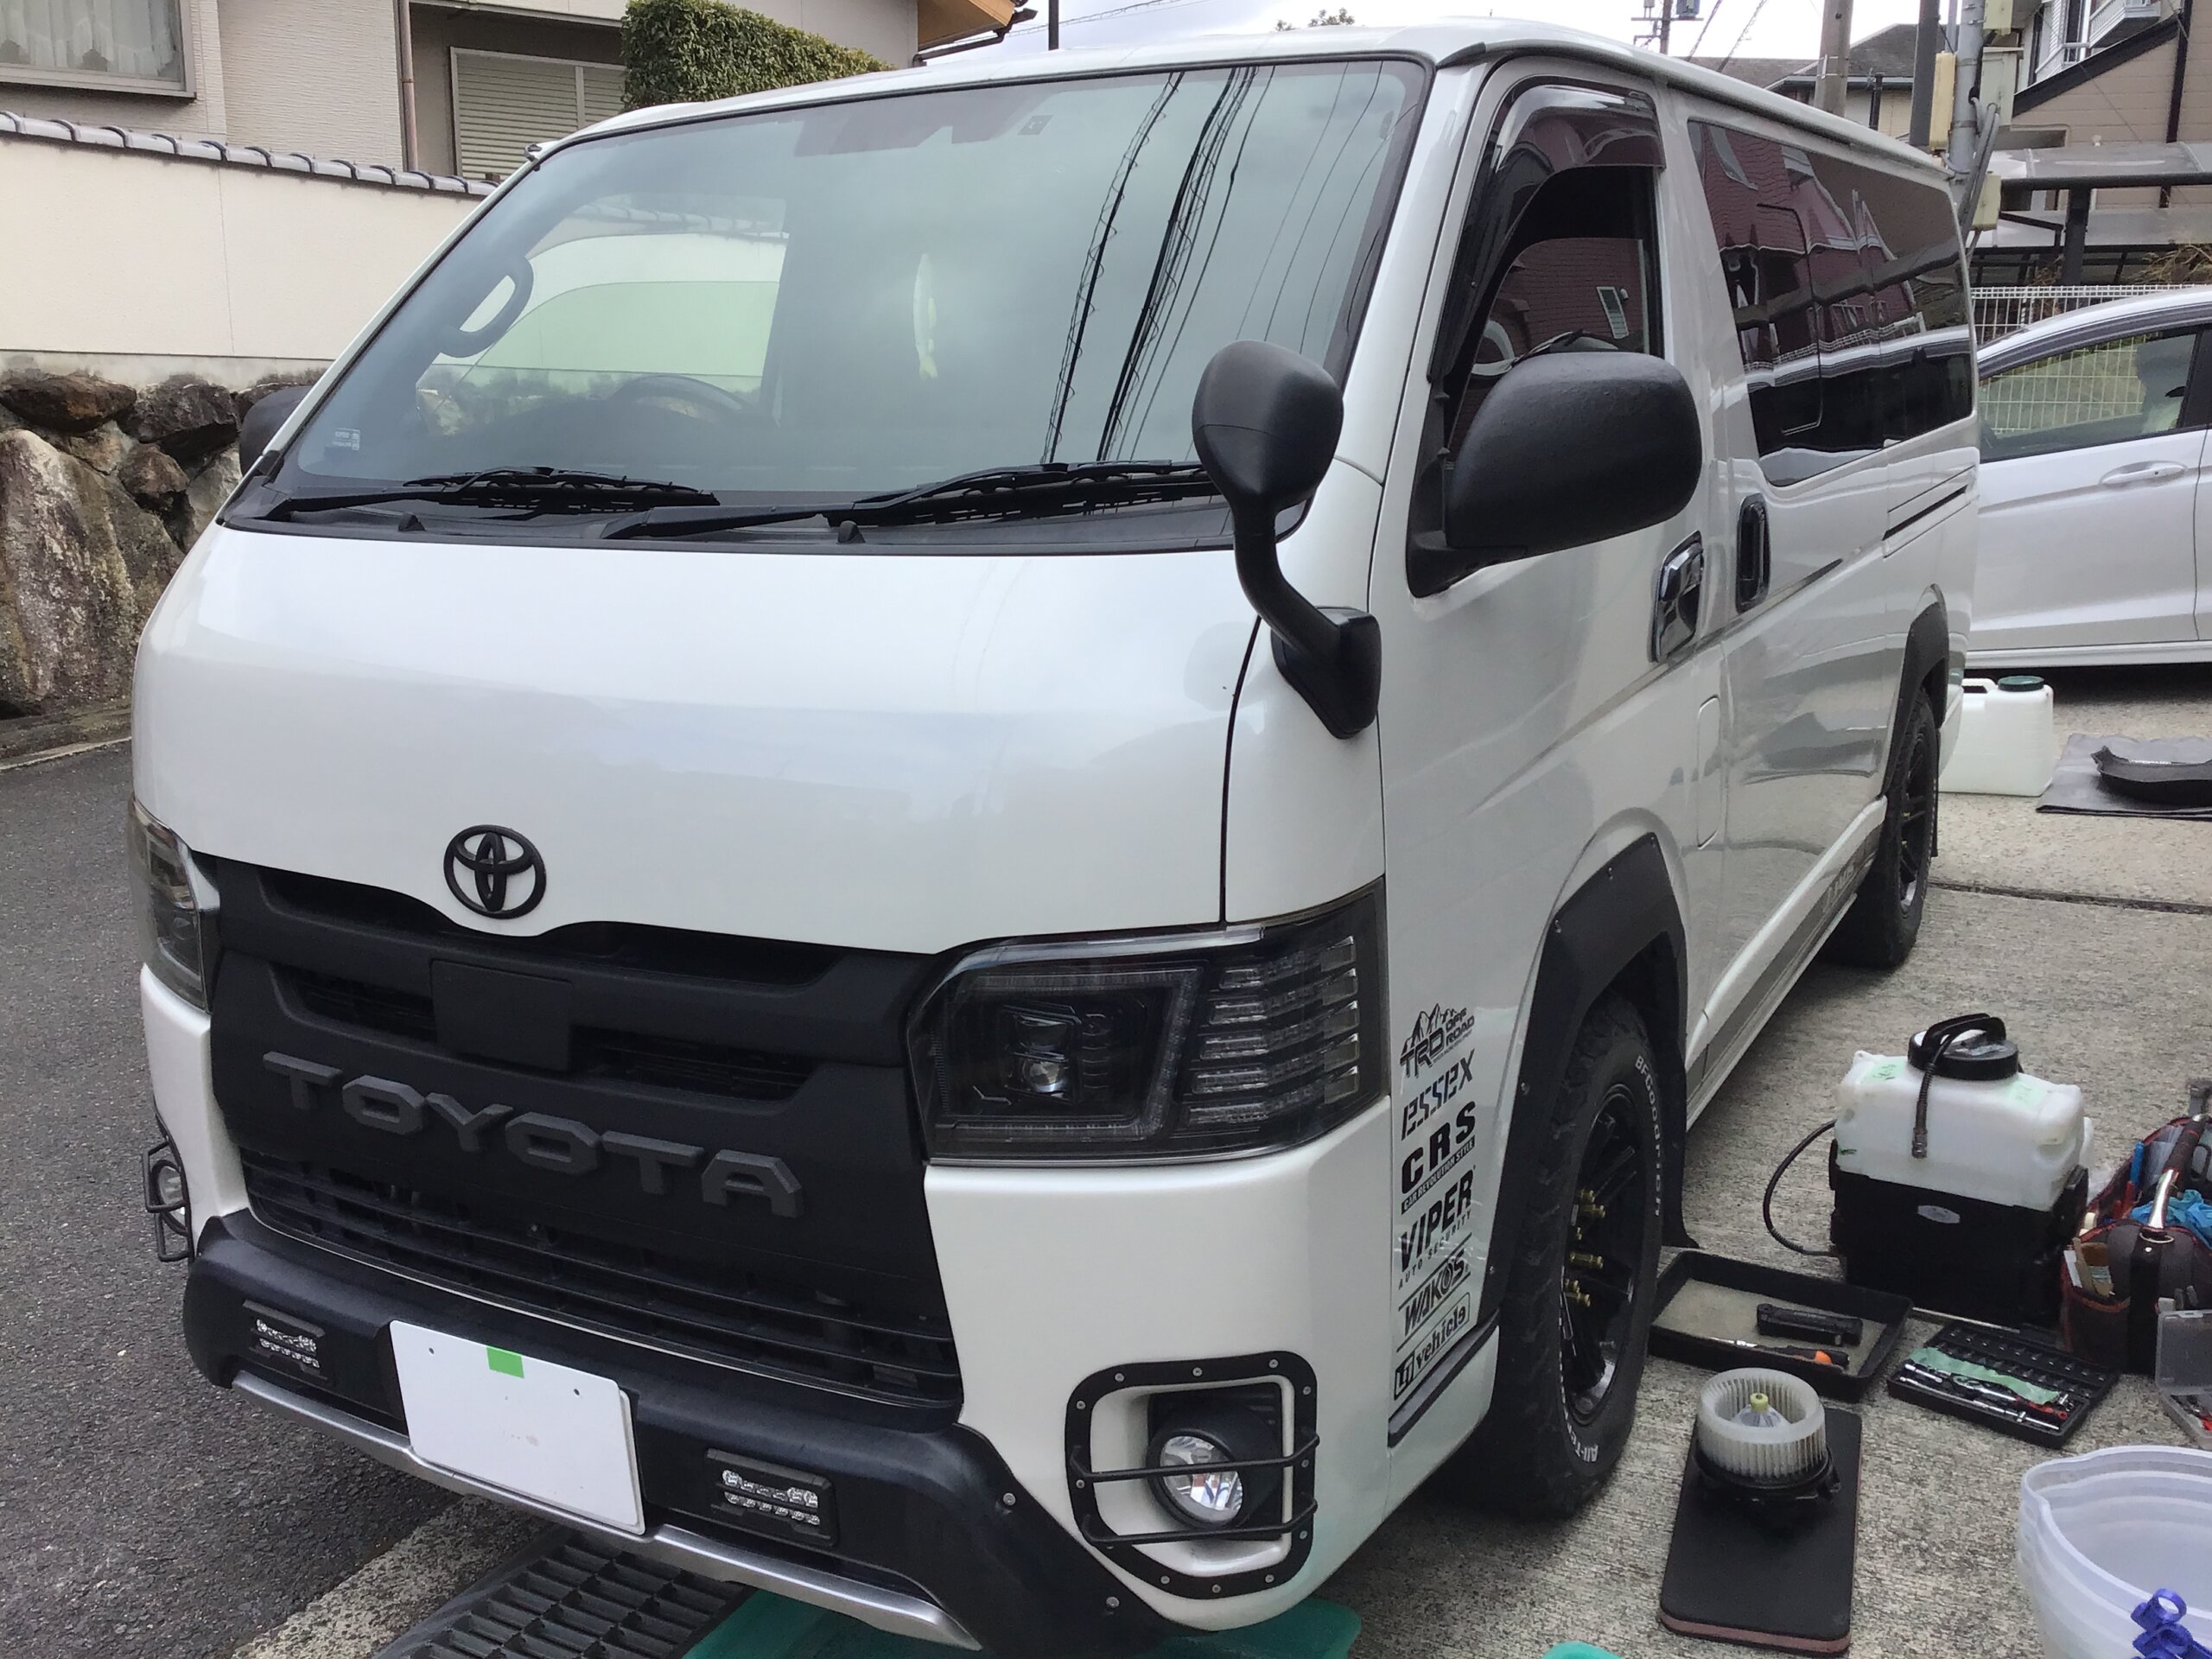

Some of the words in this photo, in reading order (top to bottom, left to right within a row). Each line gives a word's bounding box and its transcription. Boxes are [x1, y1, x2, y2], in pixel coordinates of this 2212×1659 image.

[1400, 1027, 1444, 1079] TRD
[1446, 1007, 1467, 1033] OFF
[1446, 1015, 1475, 1046] ROAD
[262, 1051, 801, 1217] TOYOTA
[1402, 1101, 1476, 1194] CRS
[1403, 1188, 1418, 1211] CAR
[1455, 1136, 1475, 1164] STYLE
[1398, 1258, 1423, 1290] AUTO
[1427, 1208, 1471, 1260] SECURITY
[1400, 1169, 1473, 1273] VIPER
[1415, 1304, 1466, 1370] vehicle
